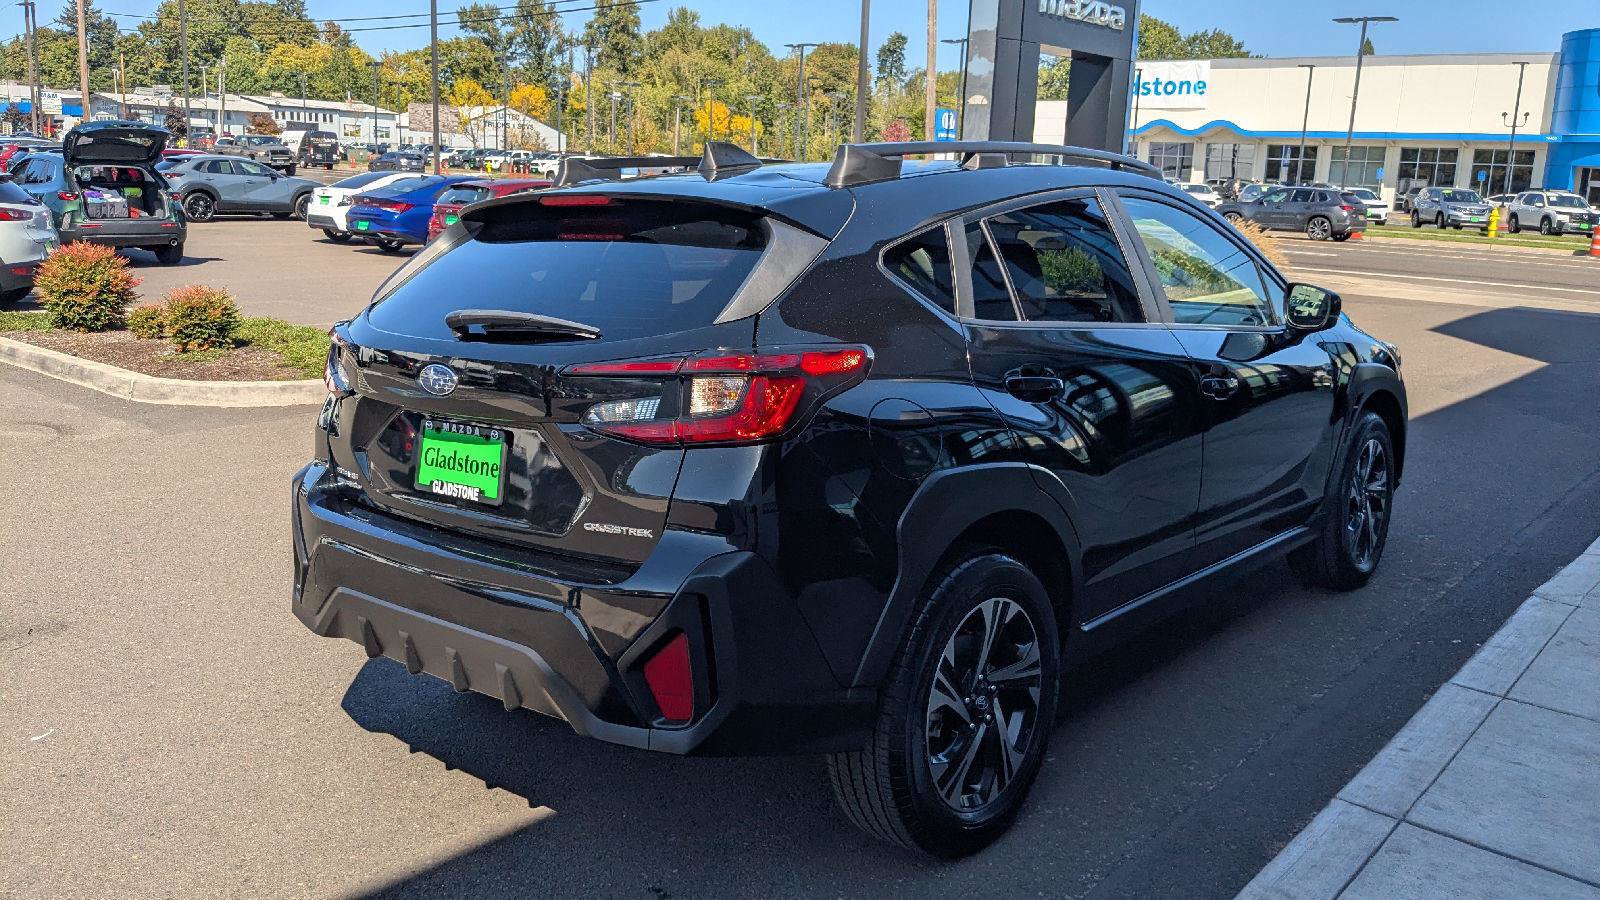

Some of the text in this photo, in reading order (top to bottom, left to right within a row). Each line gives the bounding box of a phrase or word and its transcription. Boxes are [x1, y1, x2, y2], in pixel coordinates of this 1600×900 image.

[443, 422, 480, 436] MAZDA
[424, 447, 499, 478] Gladstone
[432, 479, 480, 501] GLADSTONE
[583, 522, 653, 538] CROSSTREK
